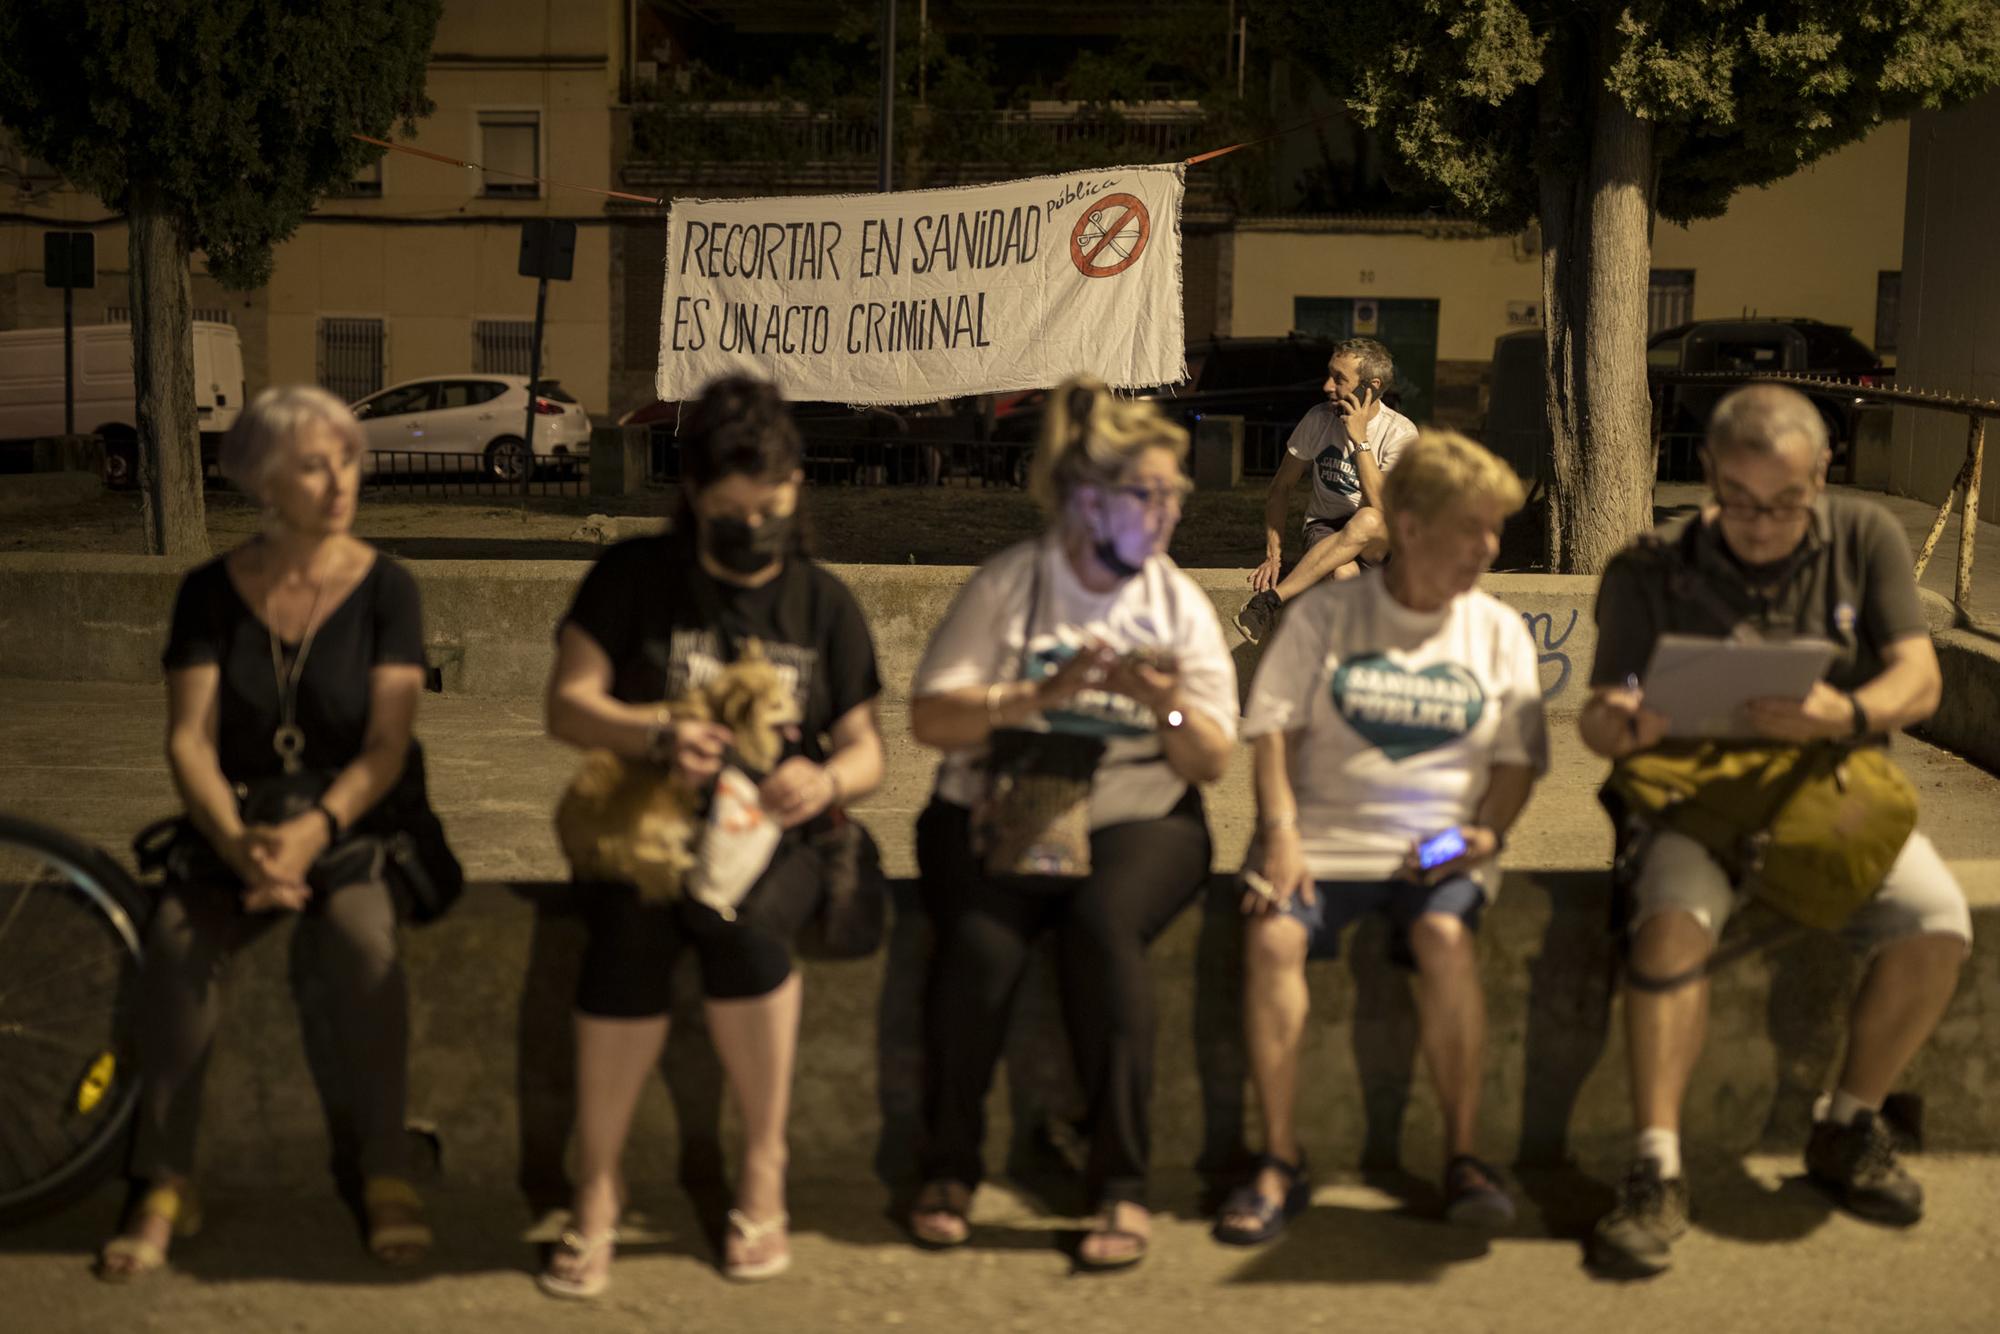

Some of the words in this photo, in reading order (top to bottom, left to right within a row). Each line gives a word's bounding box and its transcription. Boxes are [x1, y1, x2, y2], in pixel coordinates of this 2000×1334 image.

[1046, 178, 1121, 223] pública
[681, 221, 842, 281] RECORTAR
[860, 217, 903, 278] EN
[672, 296, 710, 351] ES
